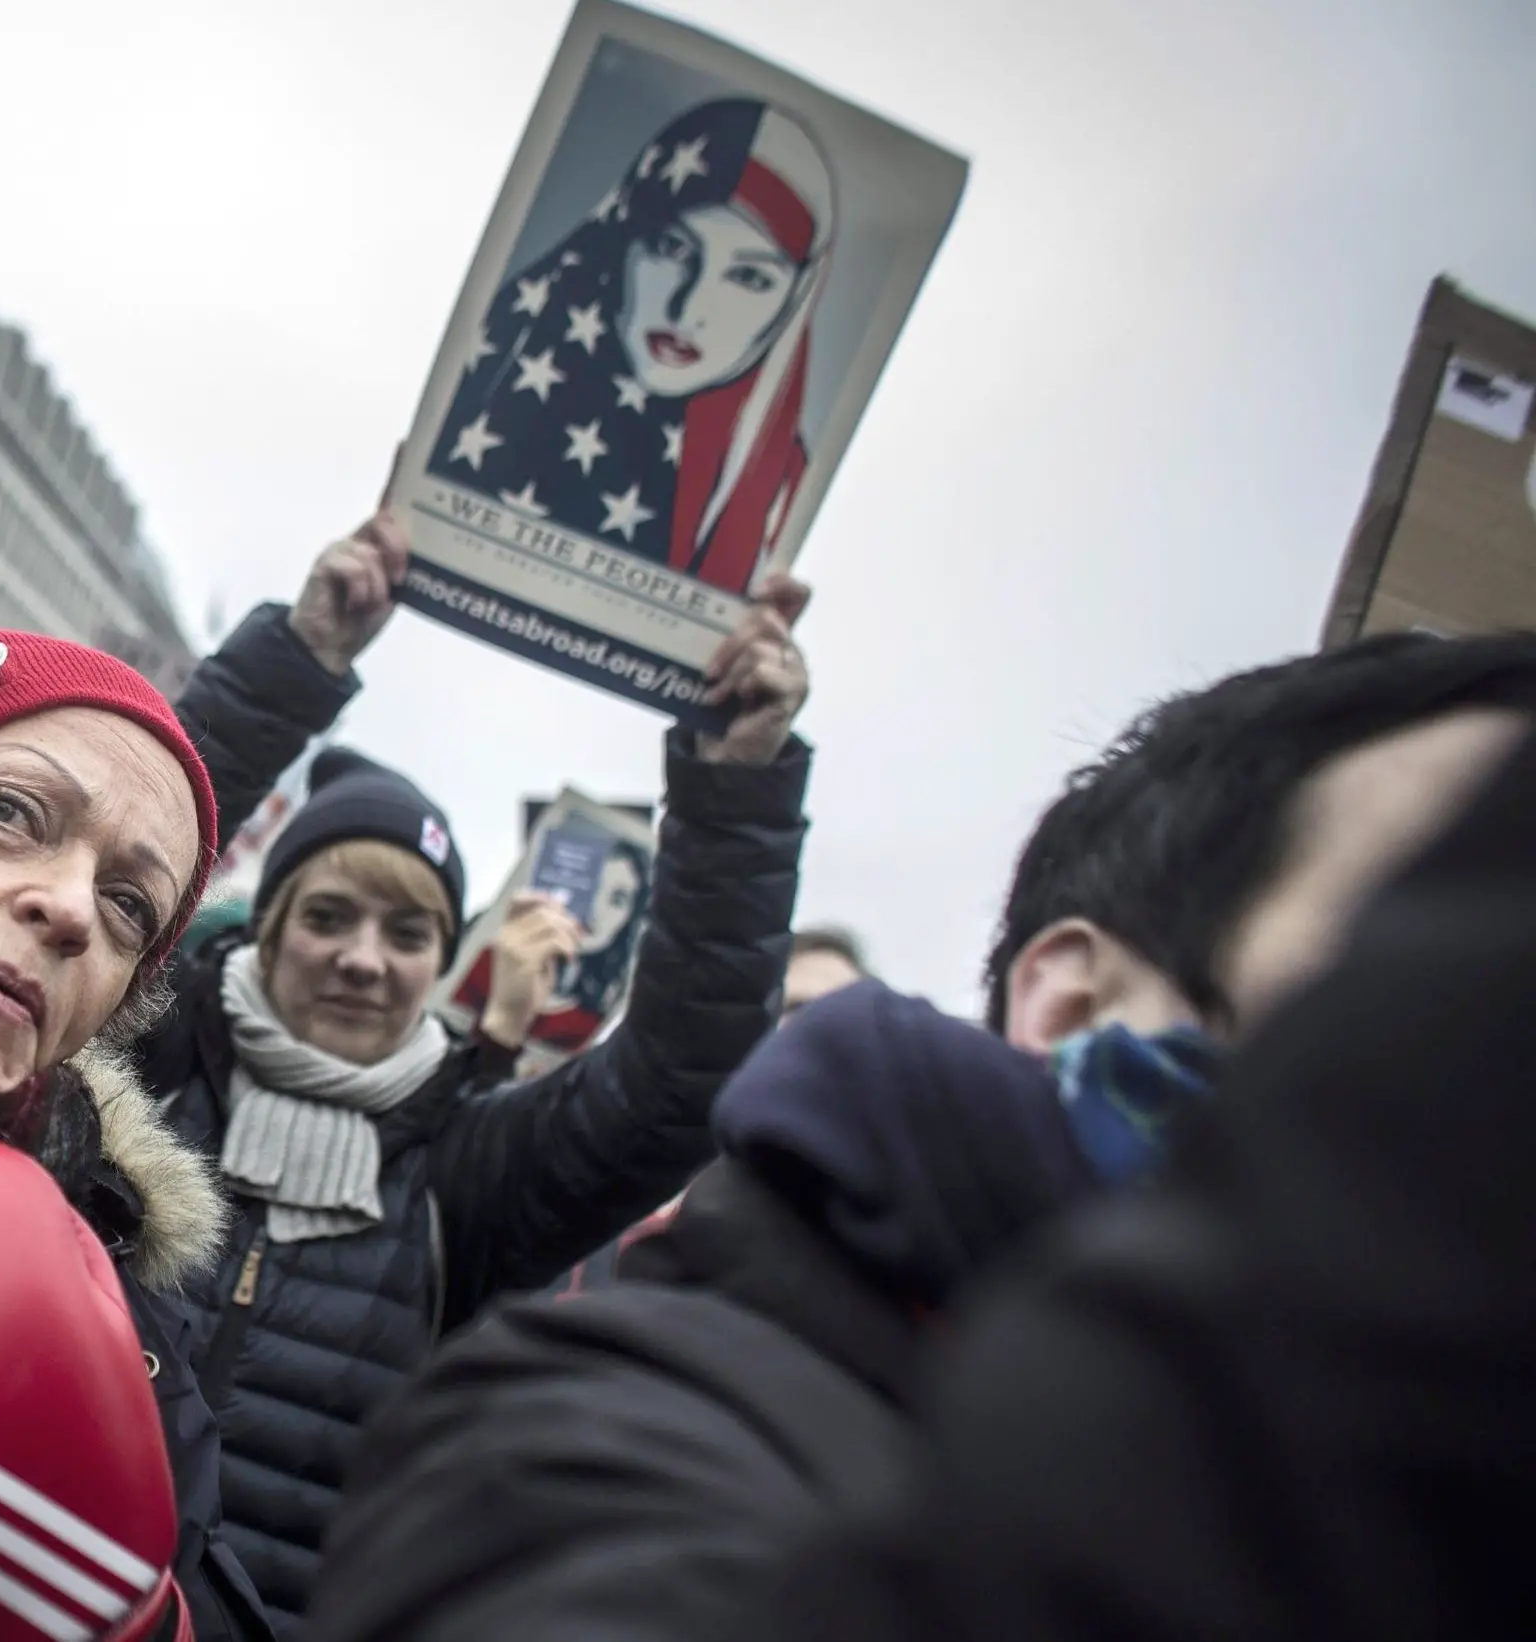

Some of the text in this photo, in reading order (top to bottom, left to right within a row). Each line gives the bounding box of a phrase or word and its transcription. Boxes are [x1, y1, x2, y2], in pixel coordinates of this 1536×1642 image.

[451, 492, 501, 532] WE
[515, 521, 576, 564] THE
[585, 549, 707, 616] PEOPLE
[404, 568, 711, 706] mocratsabroad.org/joi
